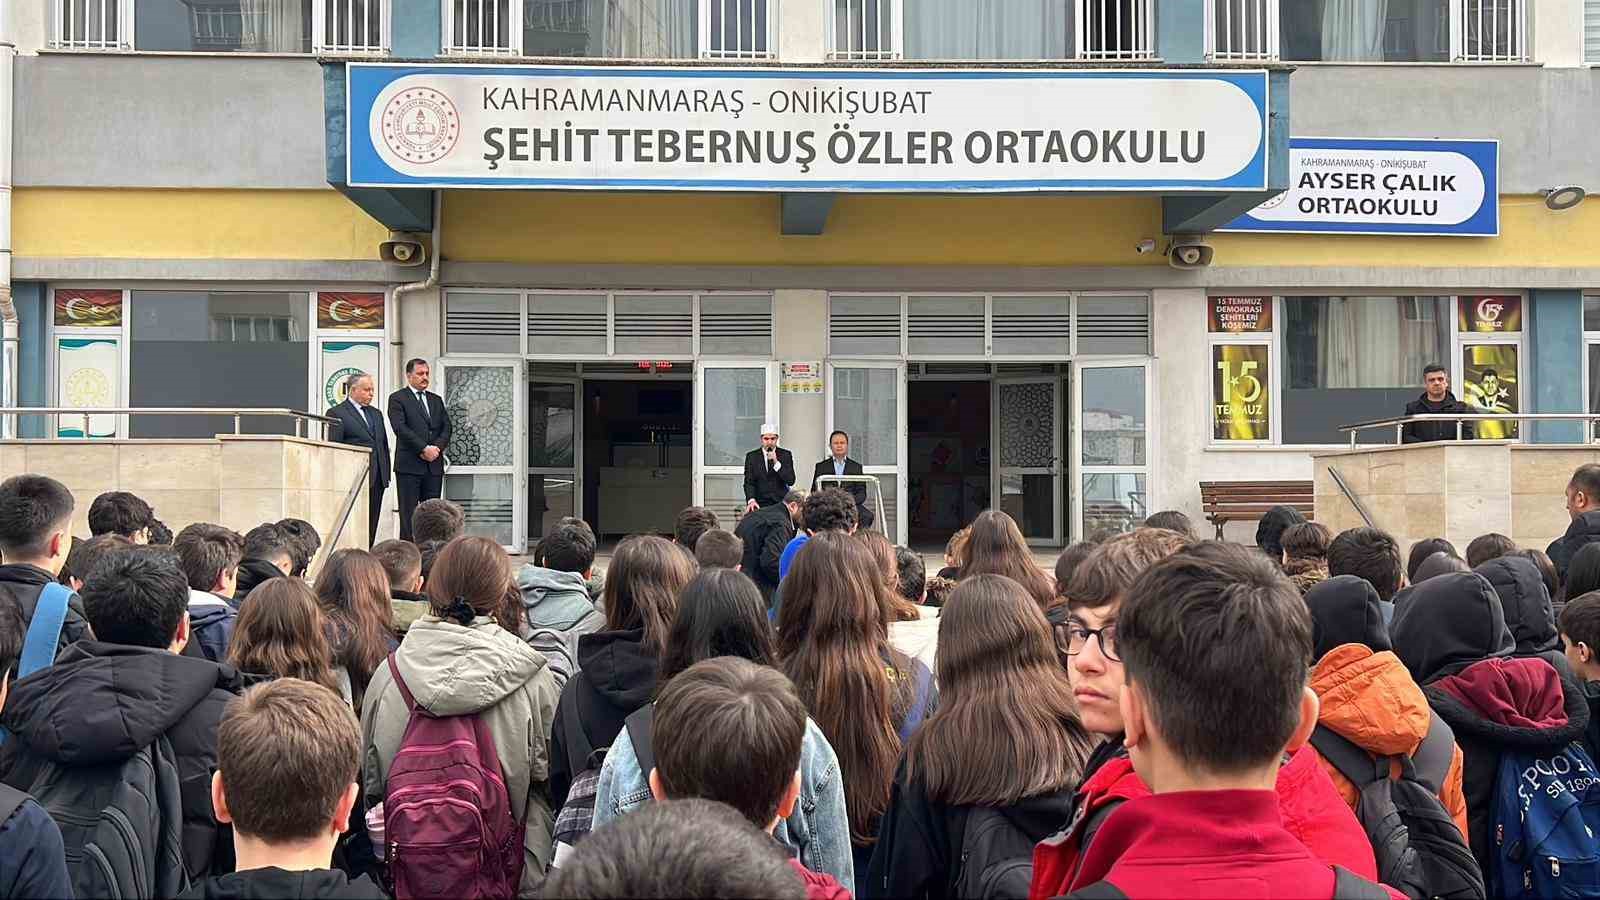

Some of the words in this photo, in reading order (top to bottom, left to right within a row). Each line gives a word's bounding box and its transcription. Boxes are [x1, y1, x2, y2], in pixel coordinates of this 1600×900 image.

[483, 86, 744, 119] KAHRAMANMARAŞ
[768, 86, 932, 120] ONİKİŞUBAT
[483, 120, 600, 170] ŞEHİT
[607, 128, 816, 174] TEBERNUŞ
[827, 122, 954, 165] ÖZLER
[964, 129, 1206, 164] ORTAOKULU
[1301, 157, 1375, 170] KAHRAMANMARAŞ
[1381, 158, 1428, 170] ONİKİŞUBAT
[1298, 172, 1376, 190] AYSER
[1382, 173, 1457, 195] ÇALIK
[1298, 197, 1438, 216] ORTAOKULU
[1216, 304, 1263, 313] DEMOKRASİ
[1227, 297, 1262, 305] TEMMUZ
[1217, 360, 1261, 402] 15
[1522, 755, 1570, 790] POO
